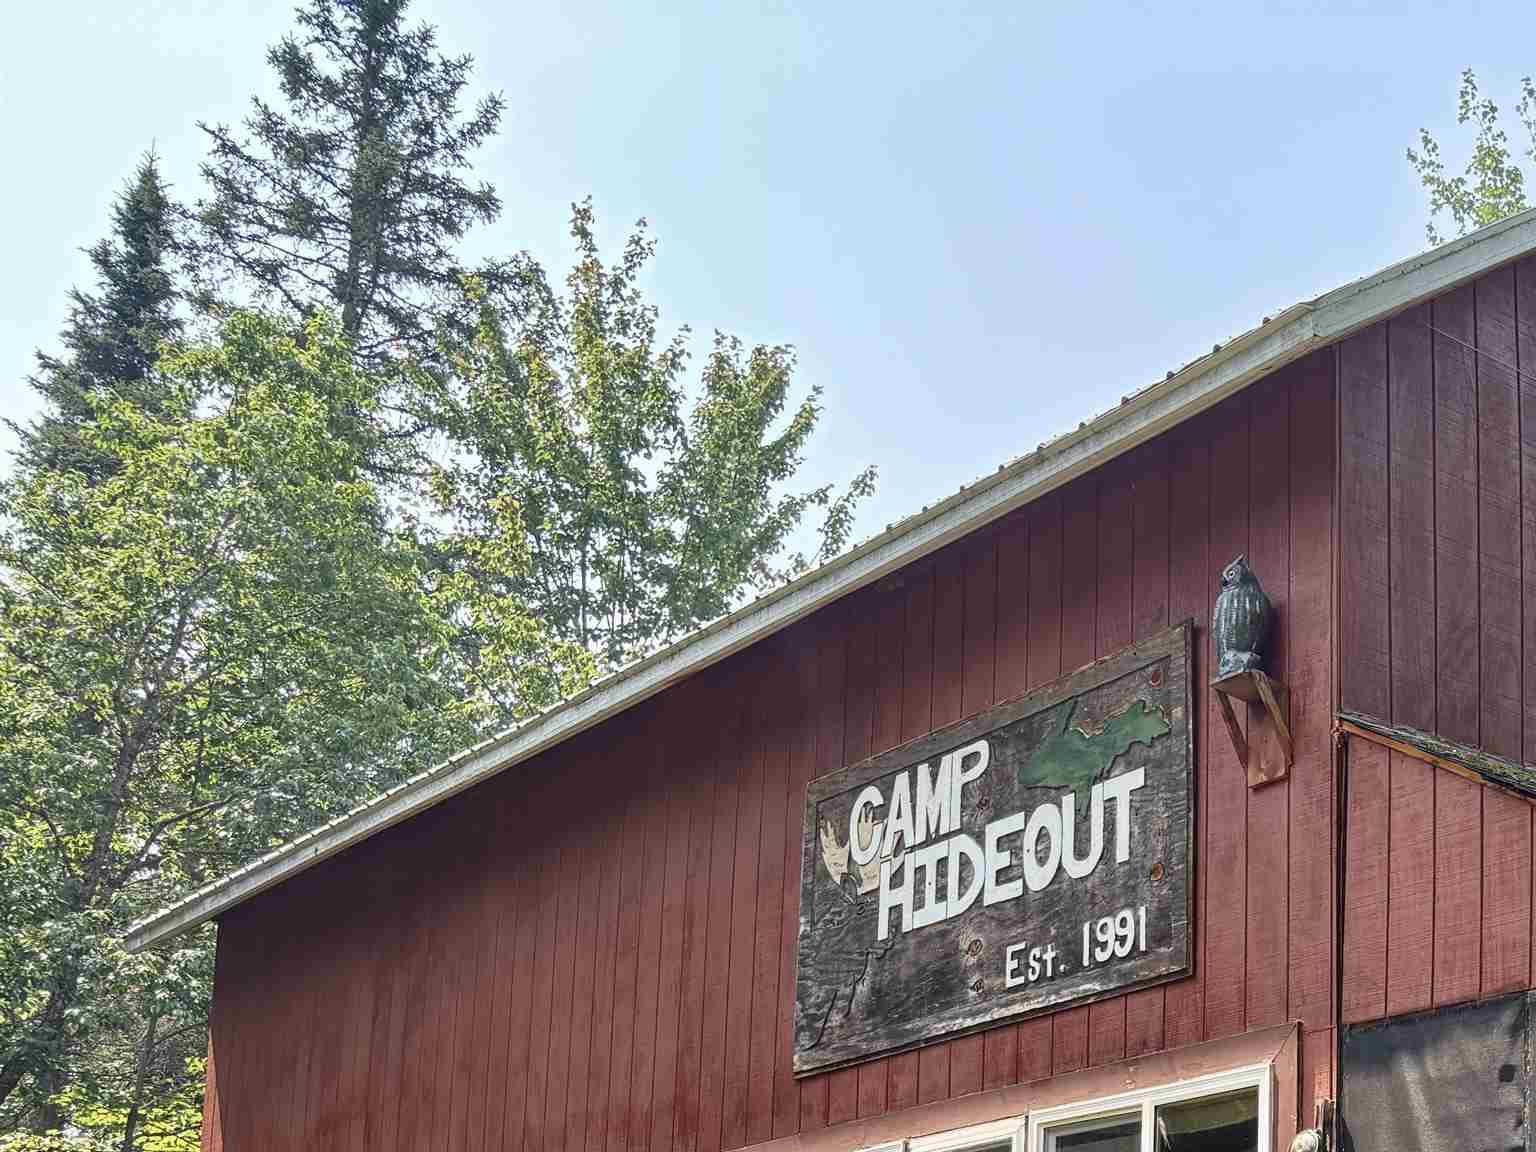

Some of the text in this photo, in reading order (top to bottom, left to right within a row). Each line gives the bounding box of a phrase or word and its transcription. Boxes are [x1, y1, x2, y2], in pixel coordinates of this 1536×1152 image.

[850, 739, 990, 866] CAMP
[877, 766, 1145, 941] HIDEOUT
[1005, 905, 1147, 989] Est. 1991
